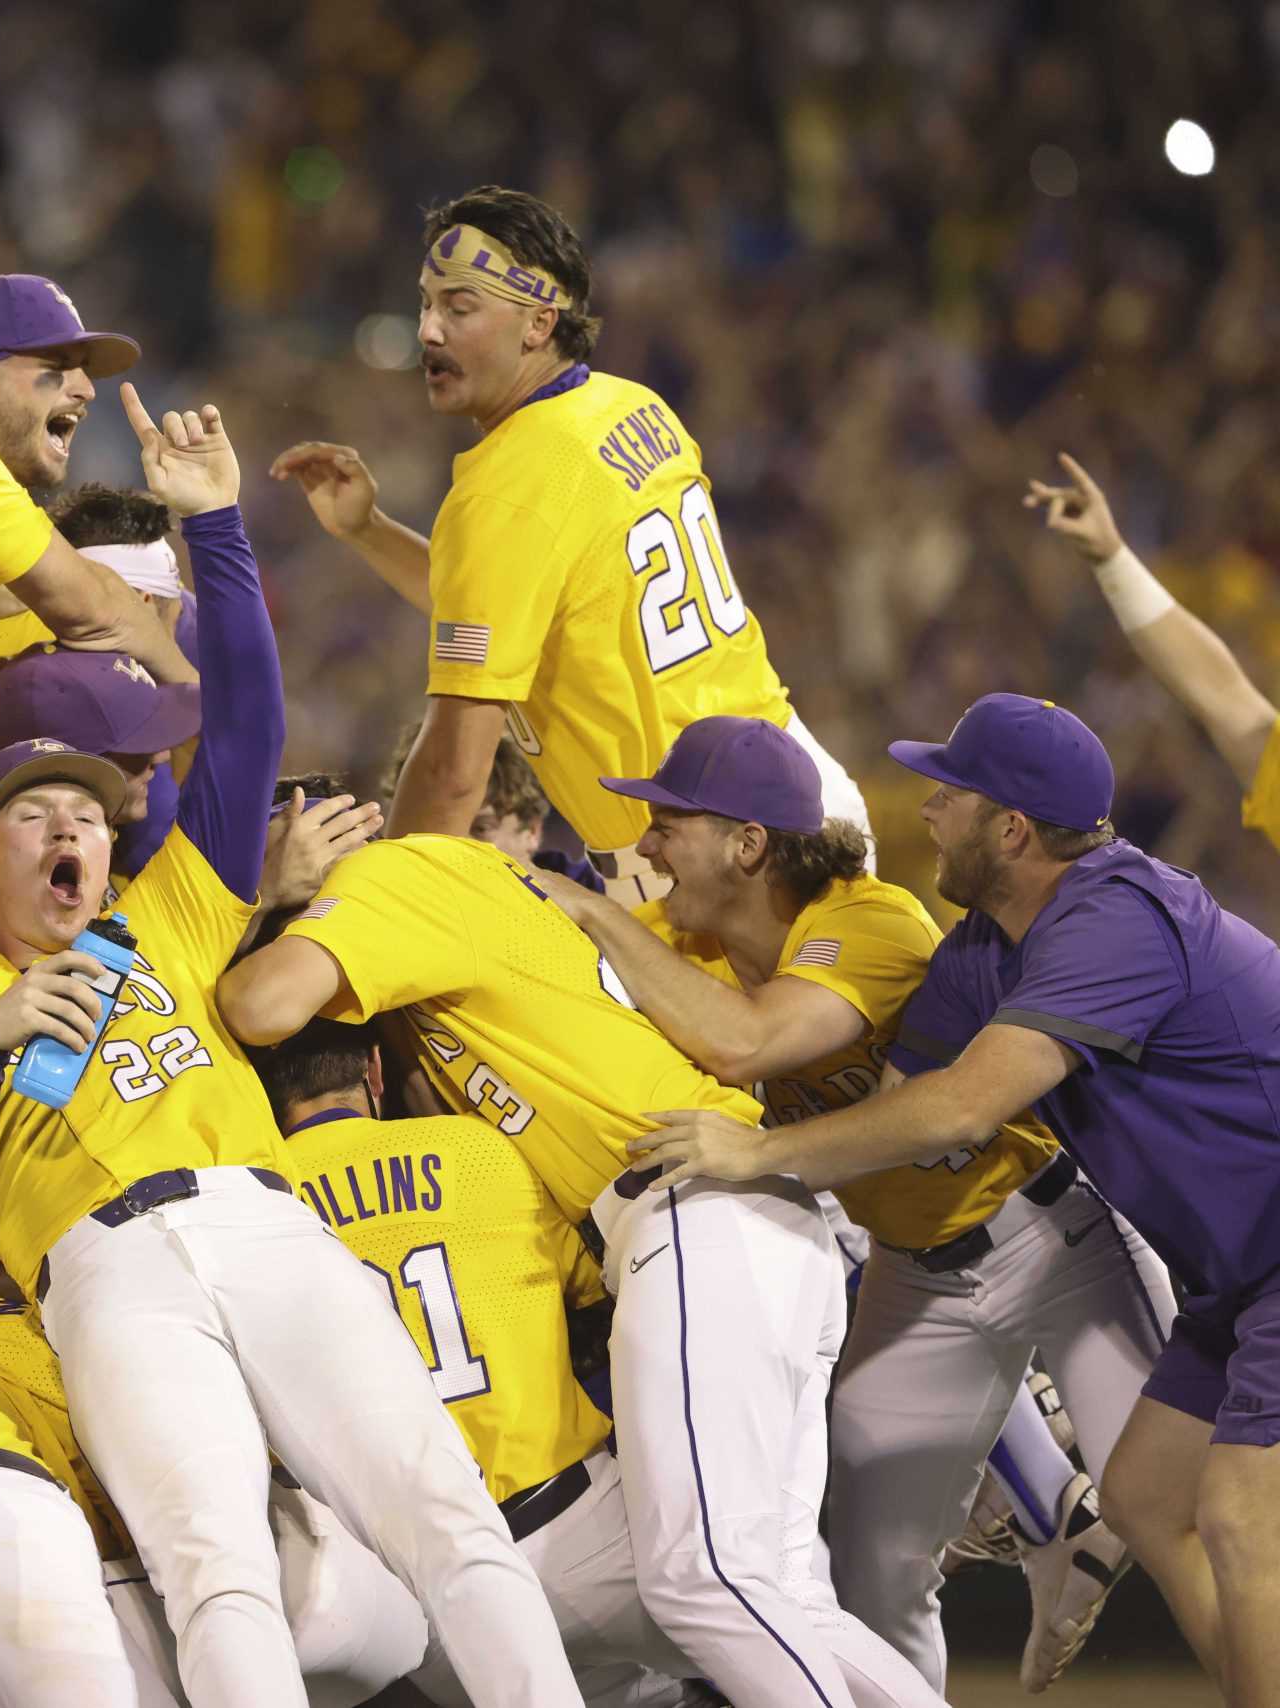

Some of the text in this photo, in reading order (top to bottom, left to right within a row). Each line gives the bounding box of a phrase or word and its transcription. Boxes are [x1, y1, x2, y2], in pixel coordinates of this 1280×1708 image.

[472, 249, 558, 304] LSU
[599, 403, 681, 492] SKENES
[625, 479, 747, 675] 20
[100, 1026, 213, 1103] 22
